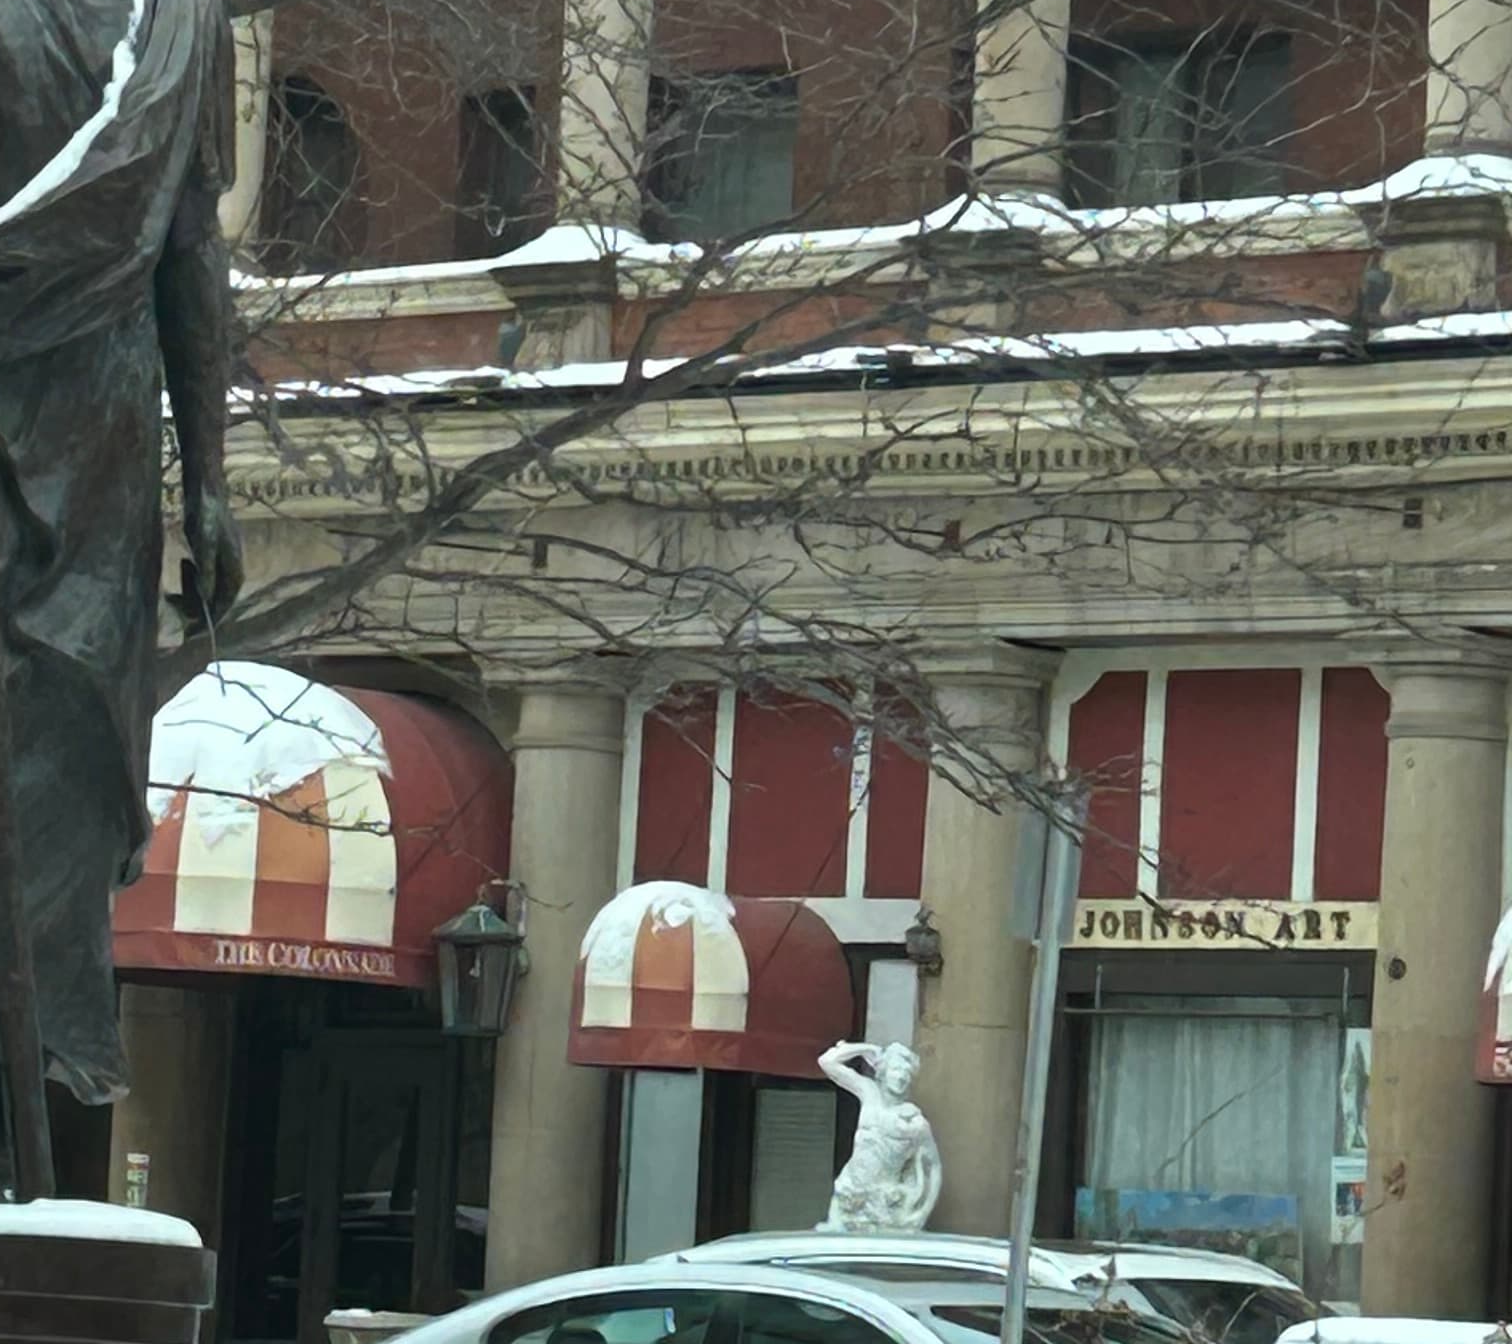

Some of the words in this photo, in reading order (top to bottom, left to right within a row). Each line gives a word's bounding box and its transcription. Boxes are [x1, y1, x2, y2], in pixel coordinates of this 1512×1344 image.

[1079, 909, 1245, 941] JOHNSON
[1275, 908, 1351, 941] ART
[215, 939, 263, 966] THE
